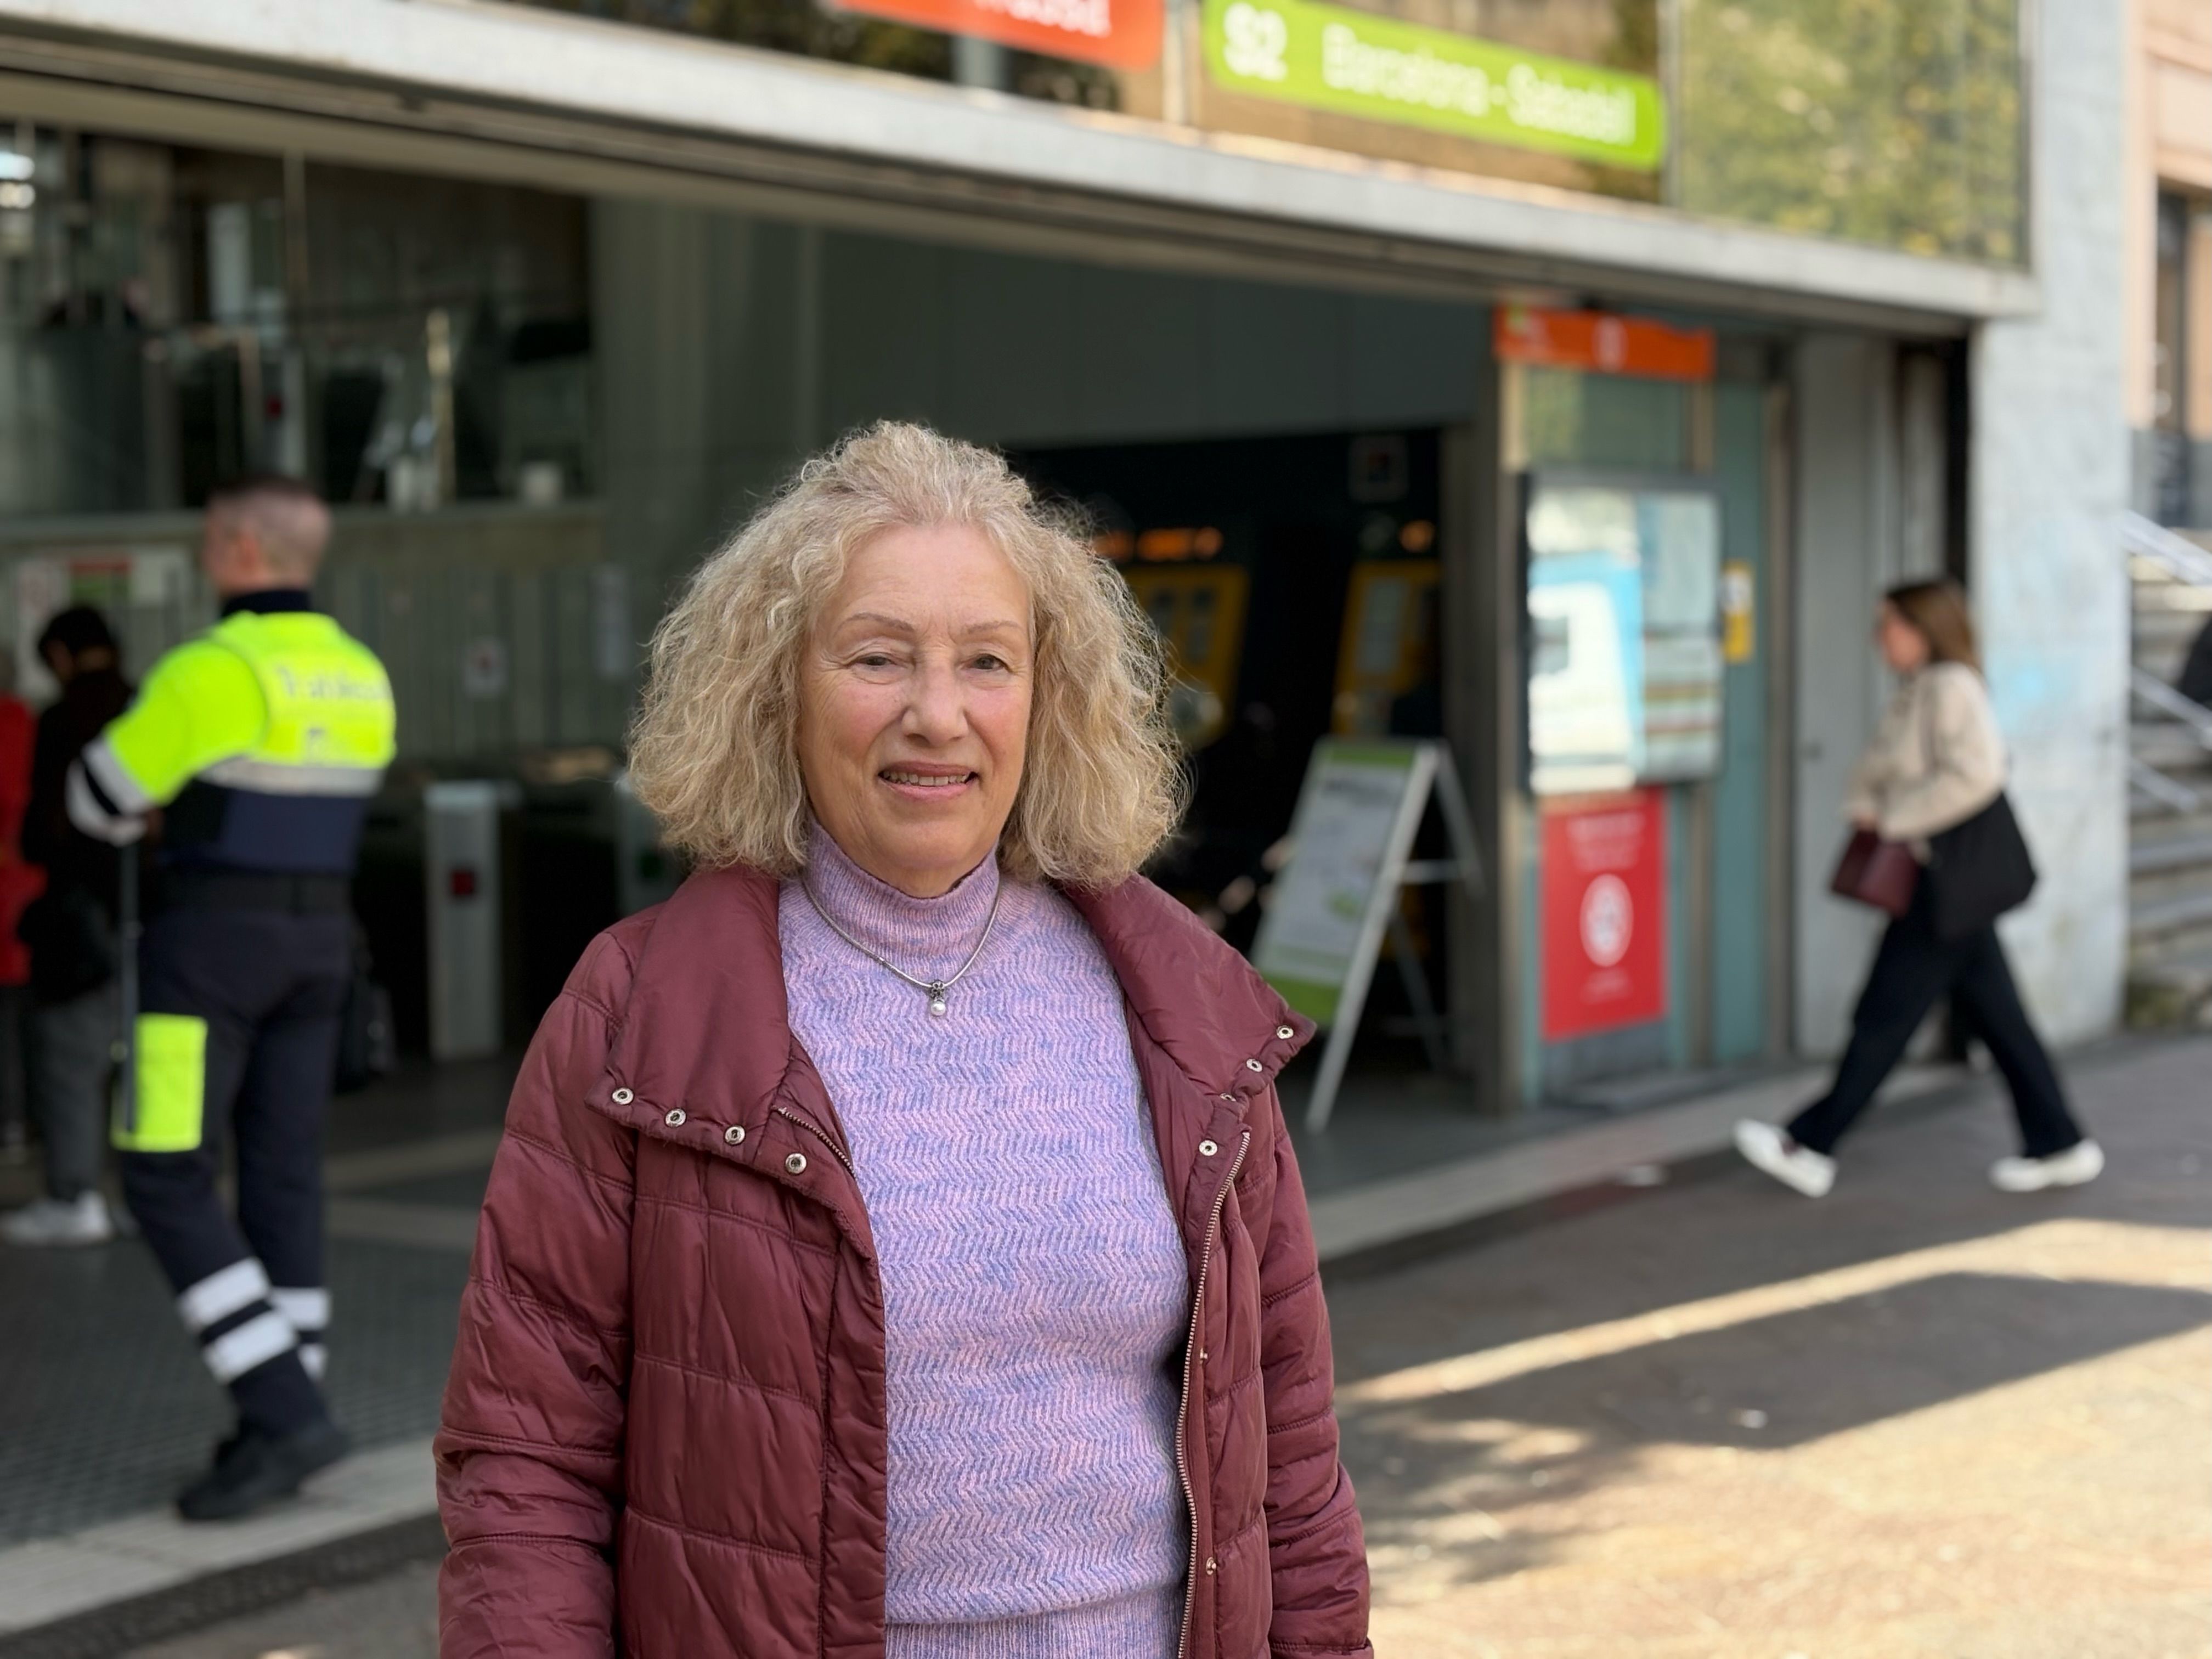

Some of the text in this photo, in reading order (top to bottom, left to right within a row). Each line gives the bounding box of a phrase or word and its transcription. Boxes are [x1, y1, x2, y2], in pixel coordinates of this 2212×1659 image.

[1224, 3, 1287, 81] S2
[1323, 23, 1489, 116] Barcelona
[1508, 64, 1635, 145] Sabadell
